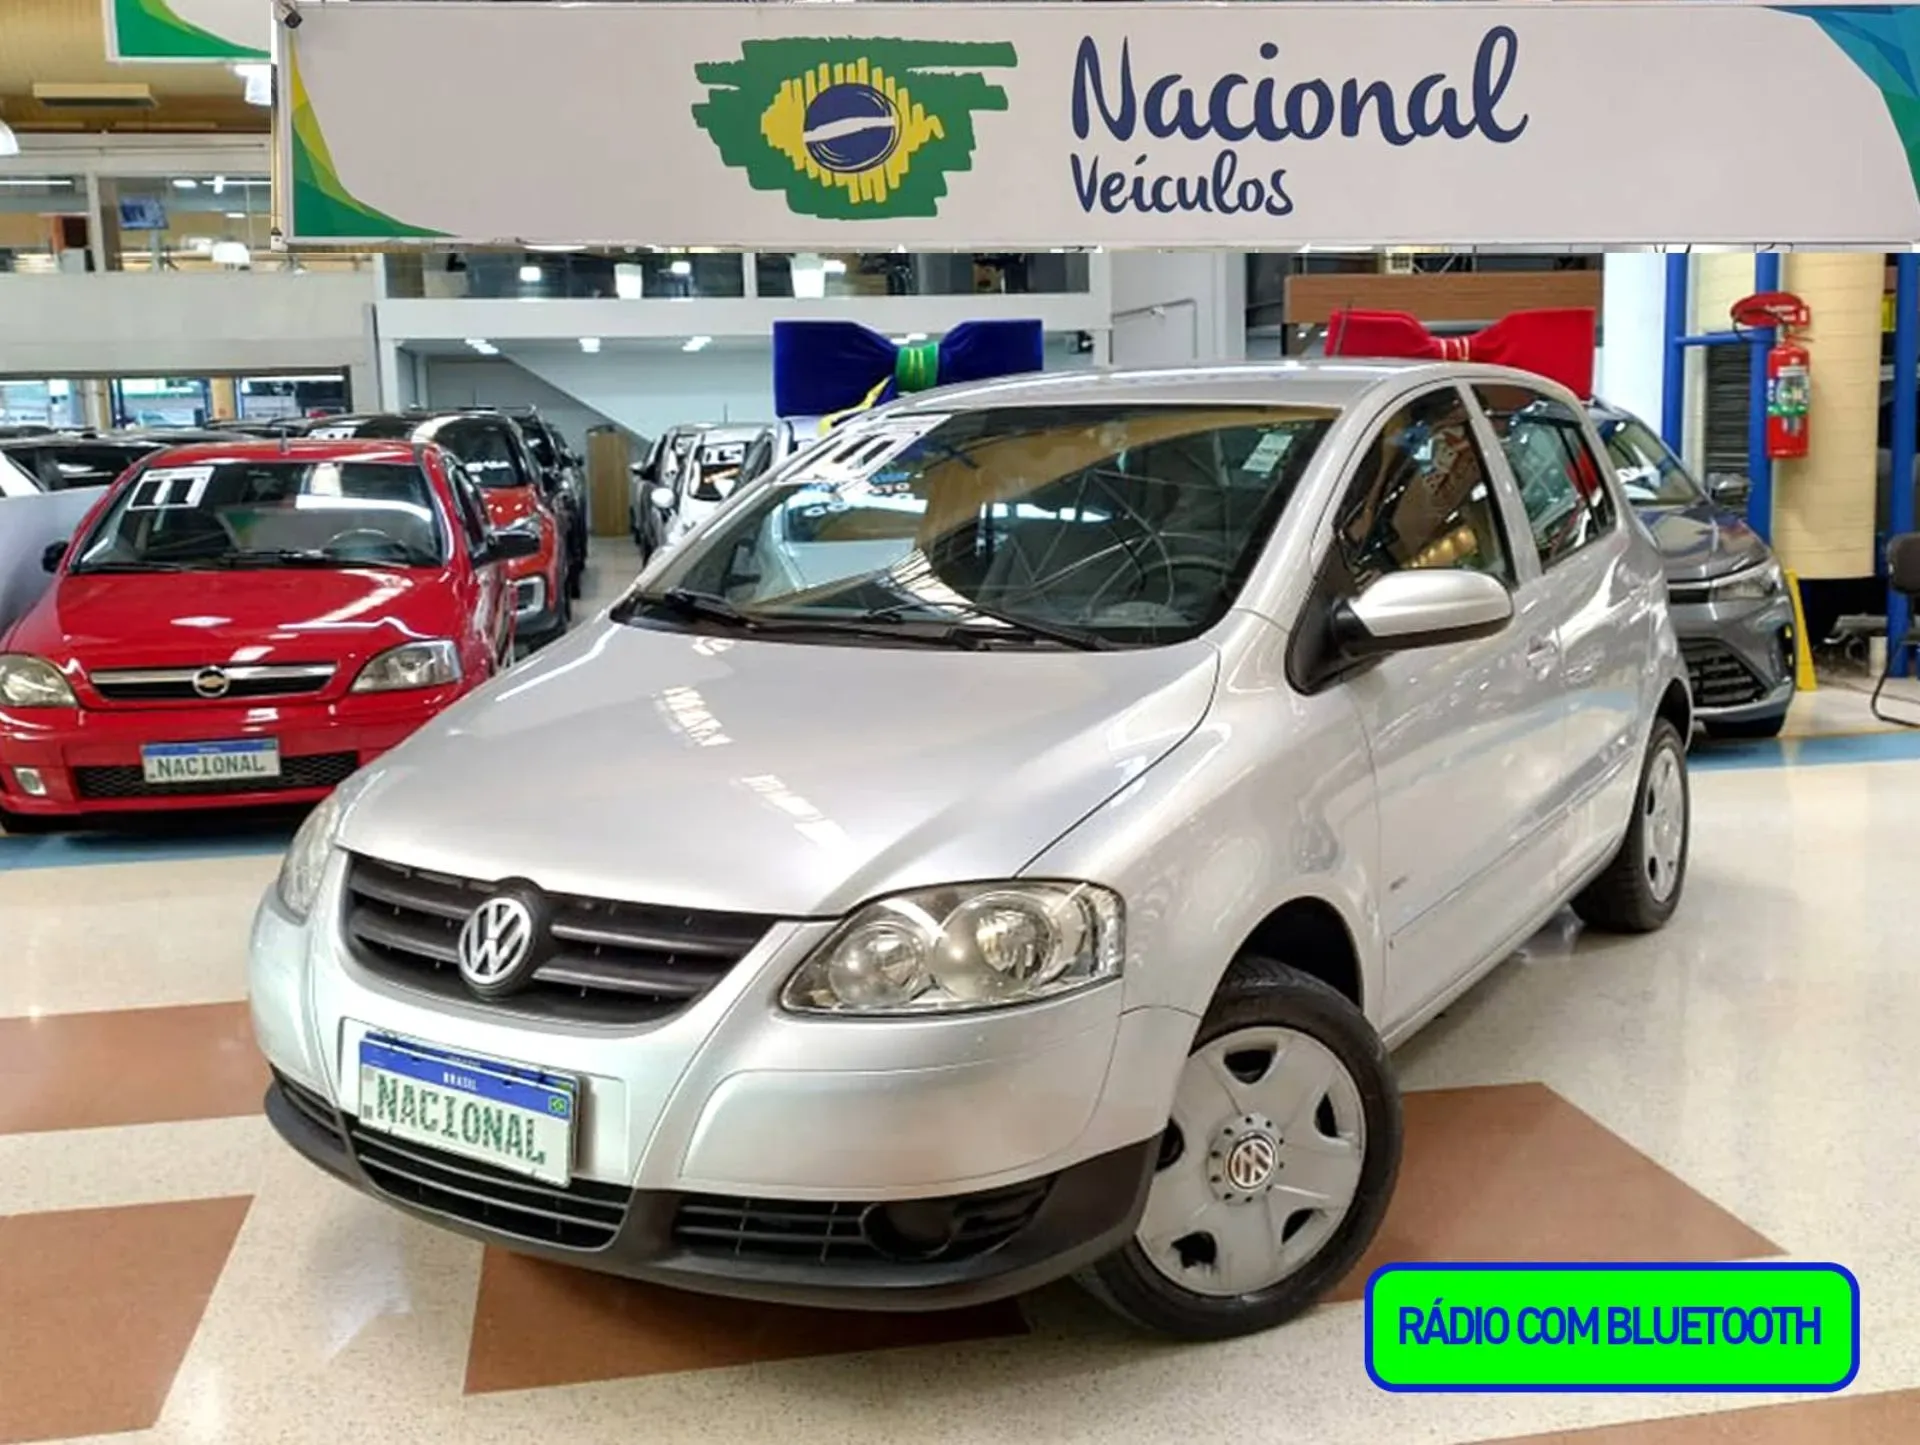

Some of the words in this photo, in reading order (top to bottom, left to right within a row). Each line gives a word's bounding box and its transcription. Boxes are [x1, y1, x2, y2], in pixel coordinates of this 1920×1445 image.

[1070, 25, 1530, 147] Nacional
[1070, 150, 1294, 215] Veículos
[156, 754, 266, 778] NACIONAL
[376, 1073, 546, 1166] NACIONAL
